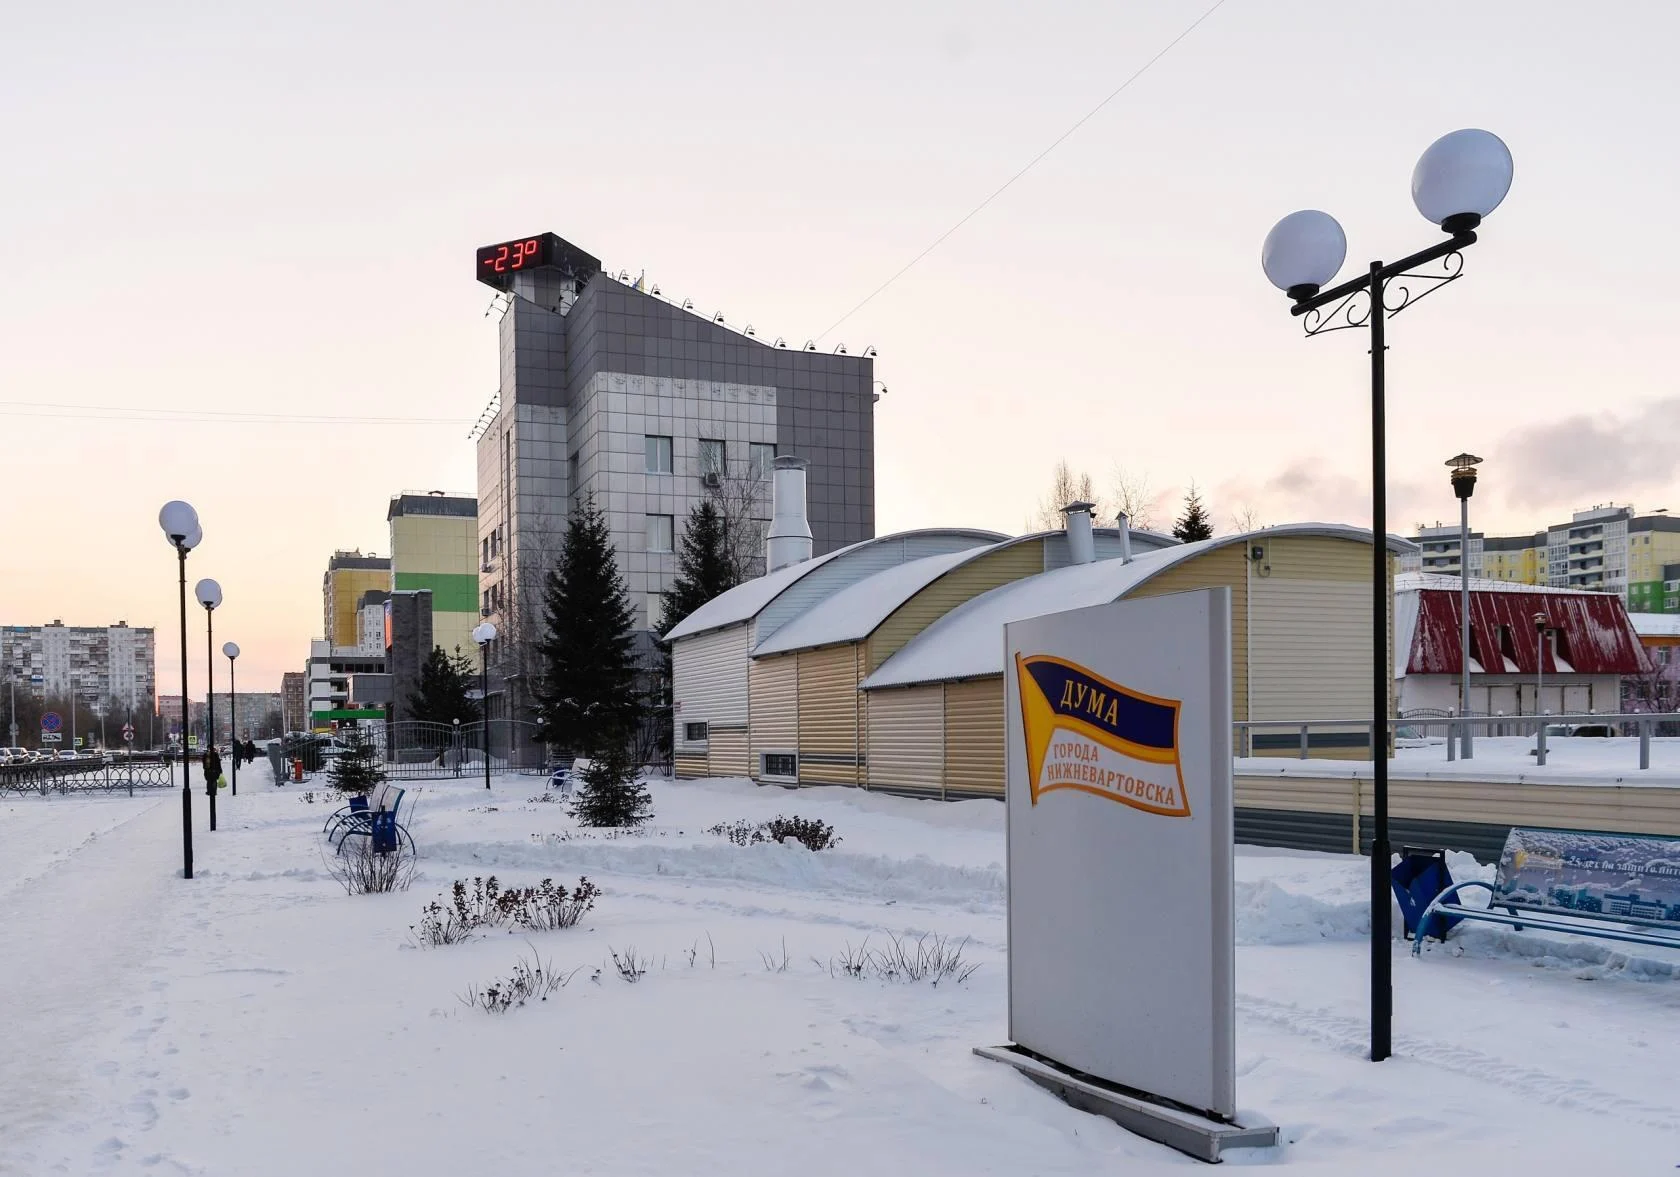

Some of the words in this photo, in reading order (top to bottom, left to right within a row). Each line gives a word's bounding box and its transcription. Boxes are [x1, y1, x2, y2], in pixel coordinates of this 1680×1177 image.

[1060, 679, 1118, 726] ДУМА
[1053, 743, 1100, 763] ГОРОДА
[1047, 763, 1176, 806] НИЖНЕВАРТОВСКА
